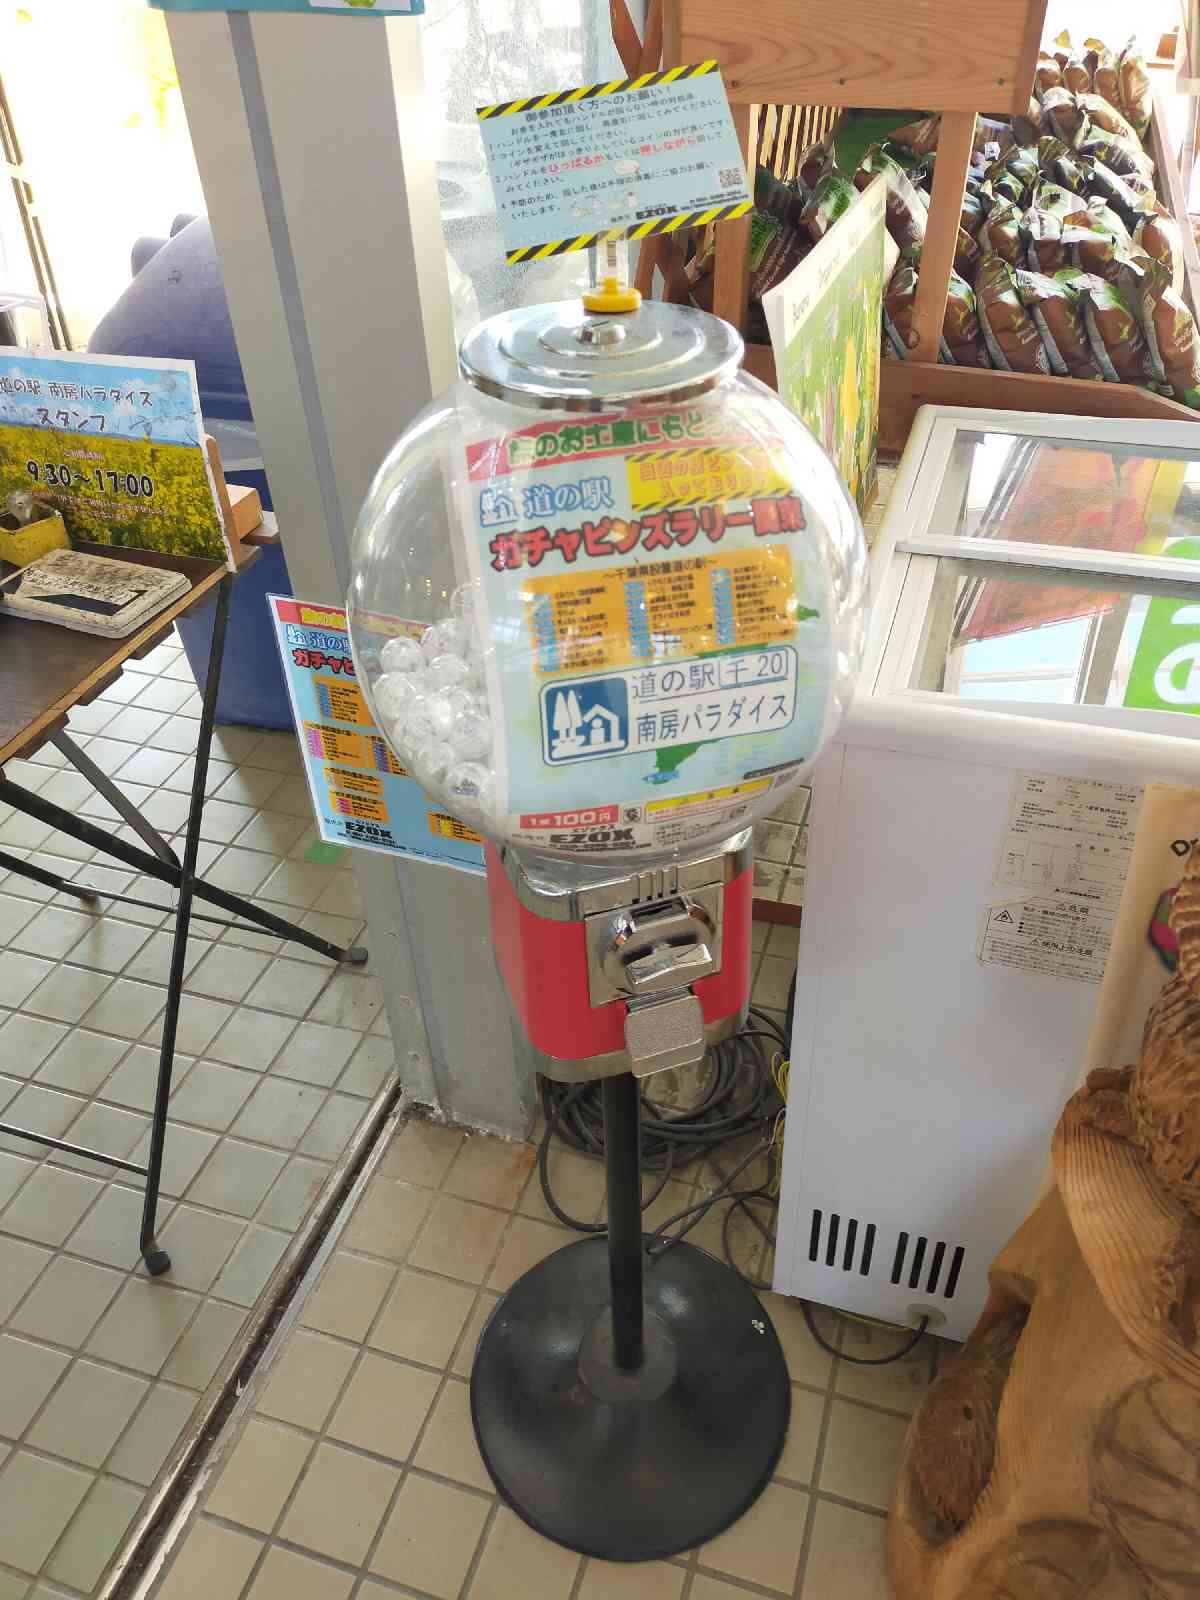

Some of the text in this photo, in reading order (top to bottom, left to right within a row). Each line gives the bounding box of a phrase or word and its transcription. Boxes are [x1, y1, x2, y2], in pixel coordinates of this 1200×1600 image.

[523, 476, 614, 520] 道の駅
[632, 662, 715, 700] 道の駅
[636, 693, 787, 745] 南房パラダイス
